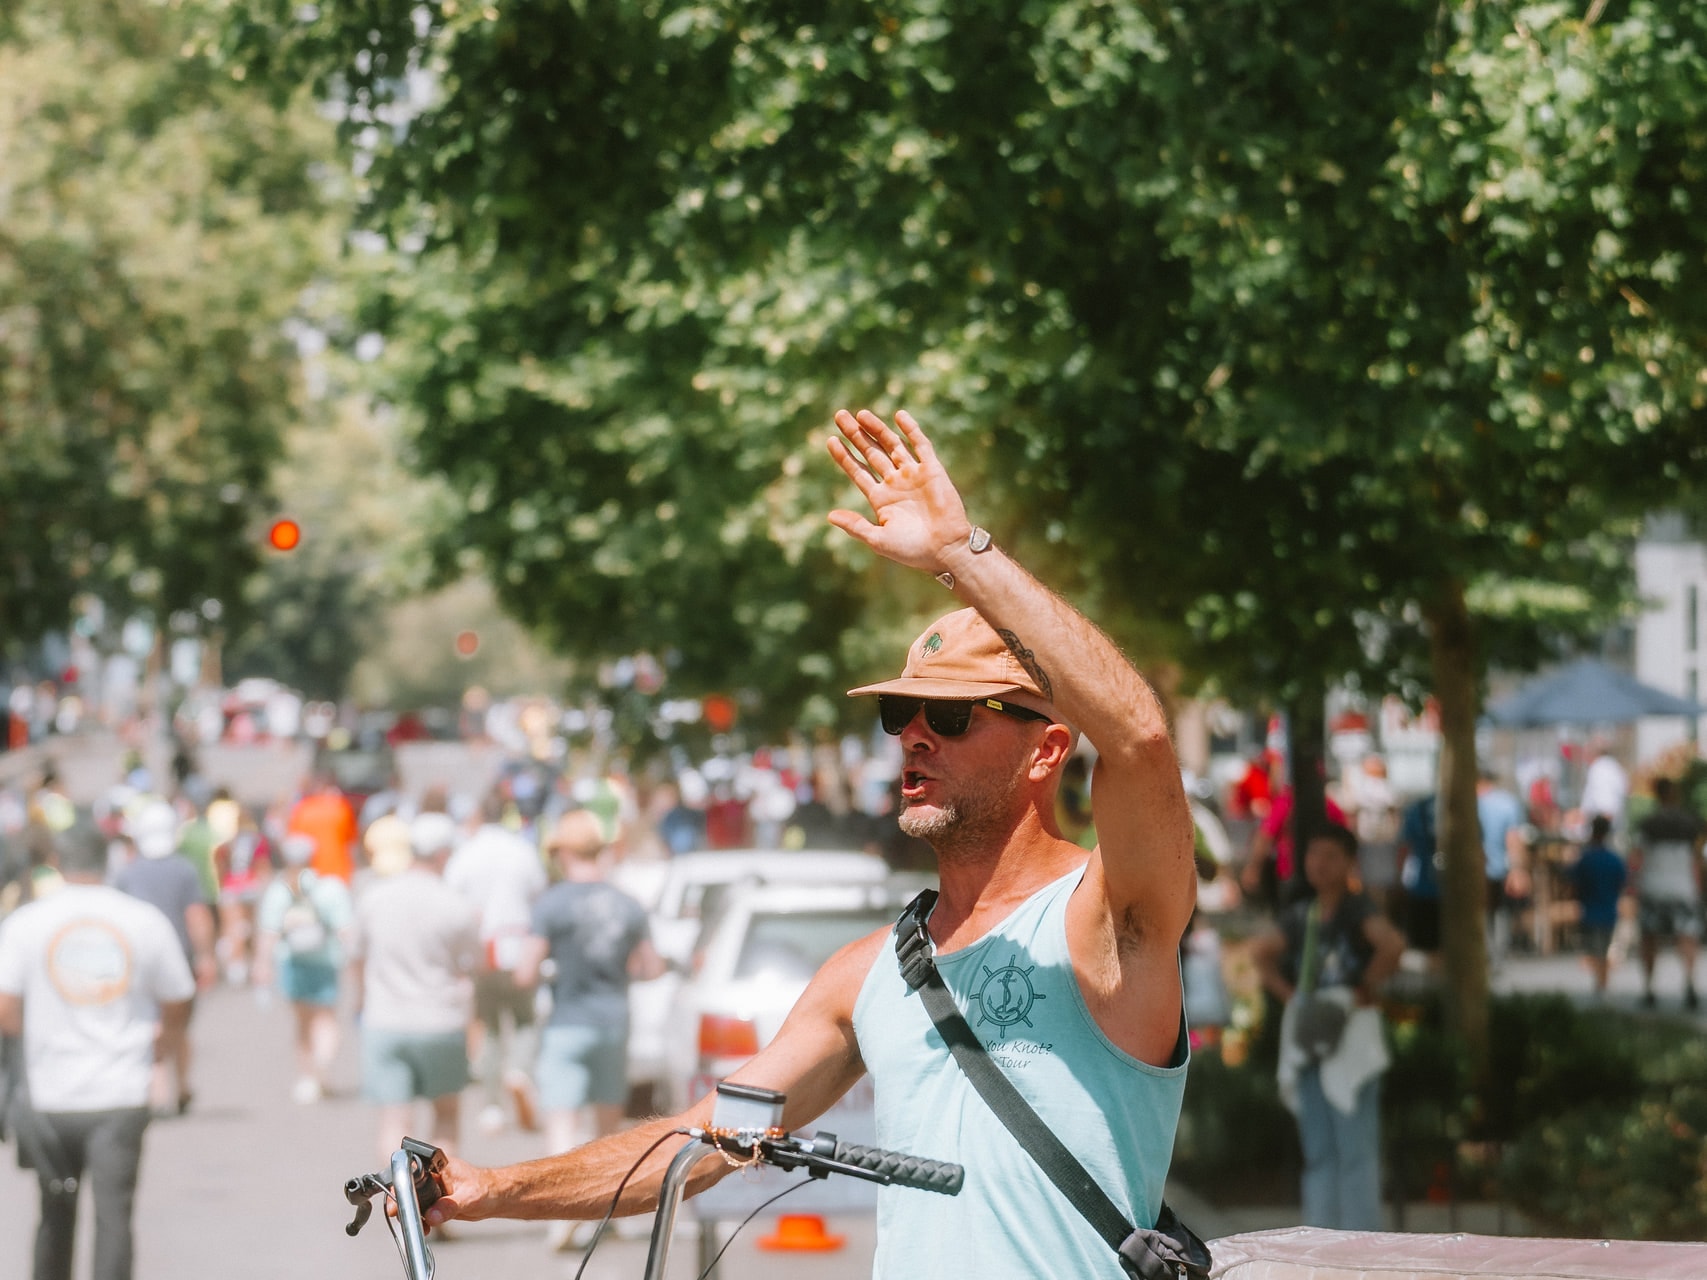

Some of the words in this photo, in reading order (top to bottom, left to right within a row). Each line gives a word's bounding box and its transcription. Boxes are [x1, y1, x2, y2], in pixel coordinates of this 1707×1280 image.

[985, 1039, 1006, 1052] You
[1011, 1040, 1053, 1055] Knot?
[999, 1056, 1031, 1069] Tour
